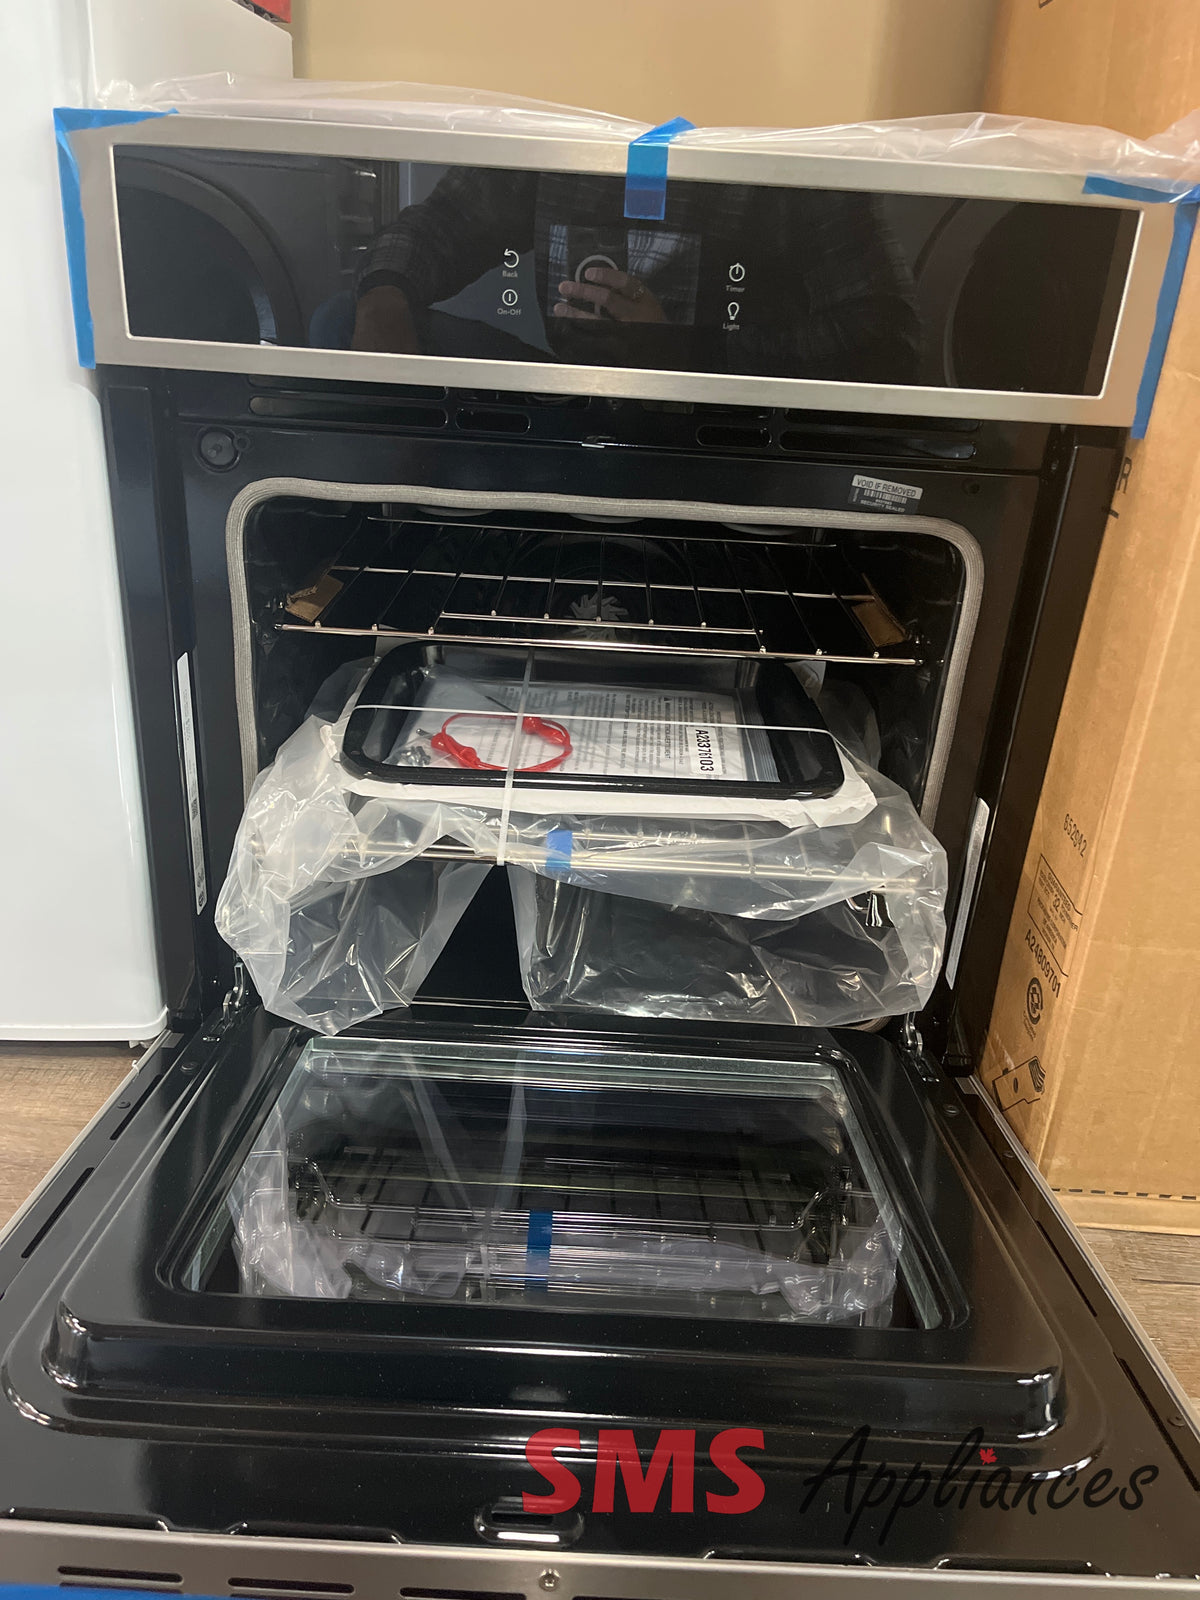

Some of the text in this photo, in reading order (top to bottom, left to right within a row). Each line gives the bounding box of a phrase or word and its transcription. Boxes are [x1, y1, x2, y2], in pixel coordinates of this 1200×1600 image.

[502, 270, 518, 278] Back
[725, 284, 745, 293] Timer
[496, 307, 522, 316] On-Off
[722, 322, 740, 331] Light
[856, 478, 917, 498] VOID IF REMOVED
